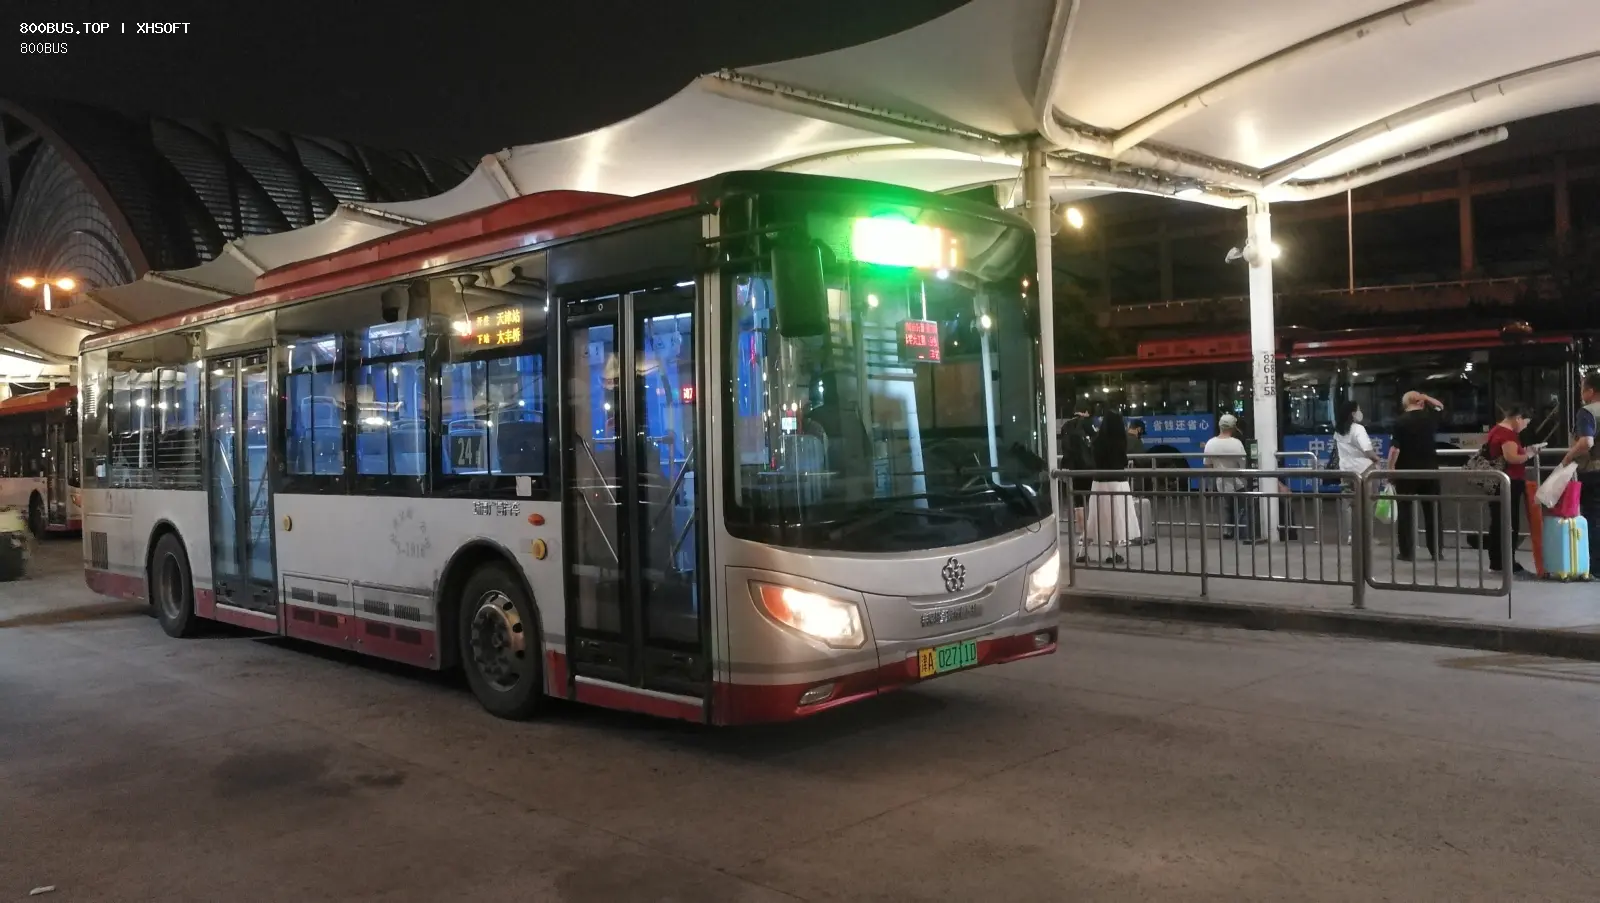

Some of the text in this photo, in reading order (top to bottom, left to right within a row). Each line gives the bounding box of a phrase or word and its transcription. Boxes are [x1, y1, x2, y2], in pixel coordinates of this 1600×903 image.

[1153, 419, 1209, 432] 省钱还省心
